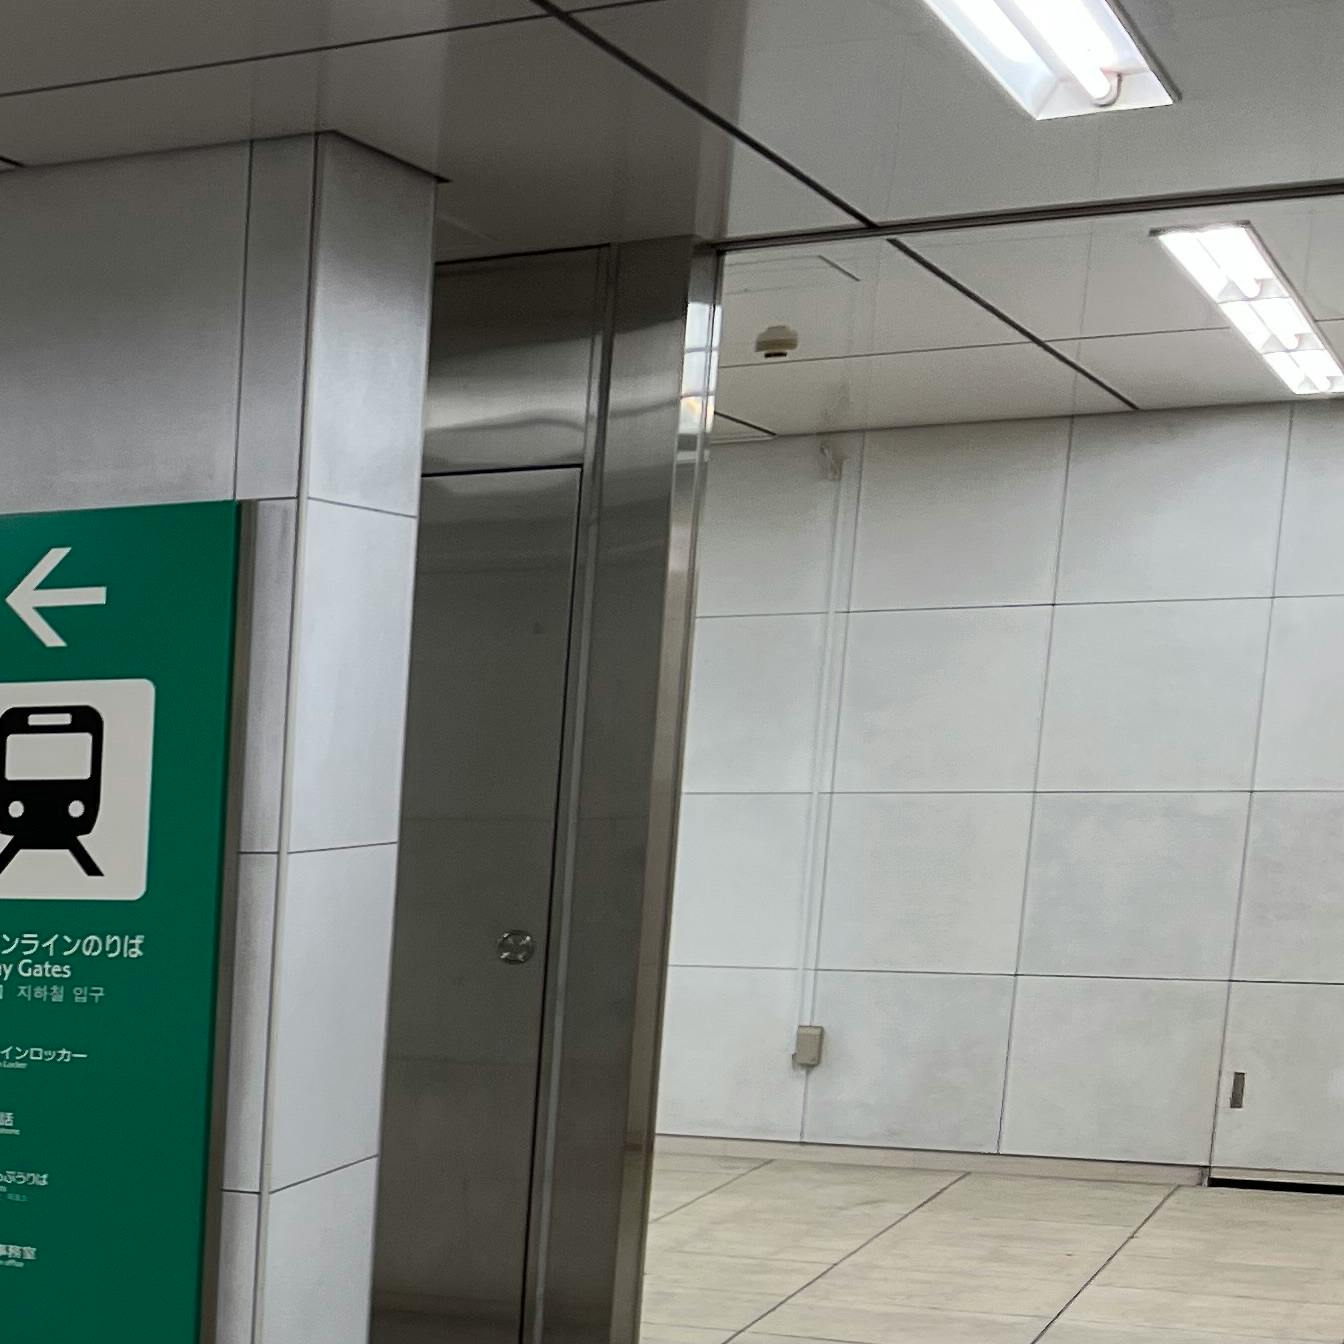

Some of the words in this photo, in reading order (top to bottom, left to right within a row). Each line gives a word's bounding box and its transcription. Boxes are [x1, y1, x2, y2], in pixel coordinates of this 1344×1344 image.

[17, 959, 72, 978] Gates
[17, 984, 64, 1002] 지하철
[73, 986, 105, 1003] 입구
